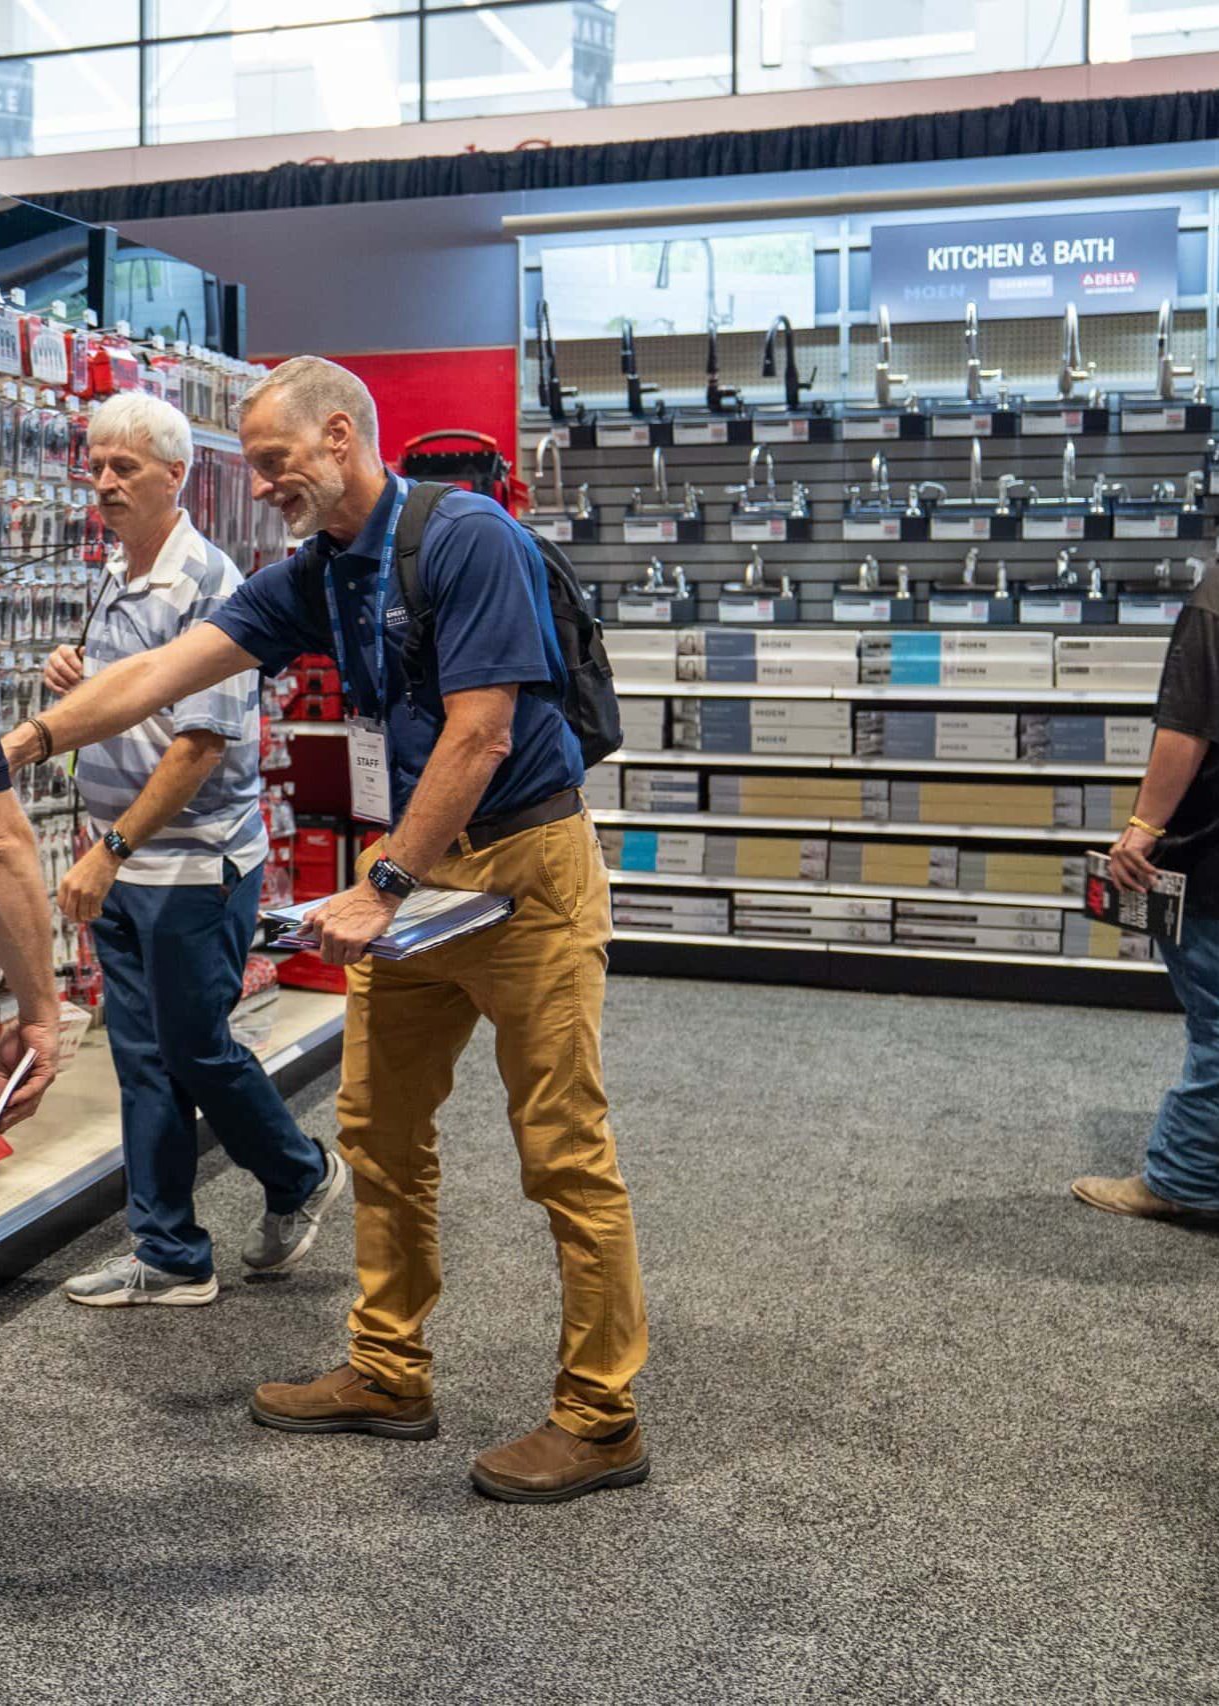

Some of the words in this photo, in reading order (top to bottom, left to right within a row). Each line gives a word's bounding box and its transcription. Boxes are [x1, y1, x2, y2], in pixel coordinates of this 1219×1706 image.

[927, 242, 1024, 271] KITCHEN
[1029, 244, 1048, 267] &
[1053, 237, 1115, 264] BATH
[1094, 271, 1136, 286] DELTA
[903, 284, 967, 301] MOEN
[356, 756, 379, 768] STAFF
